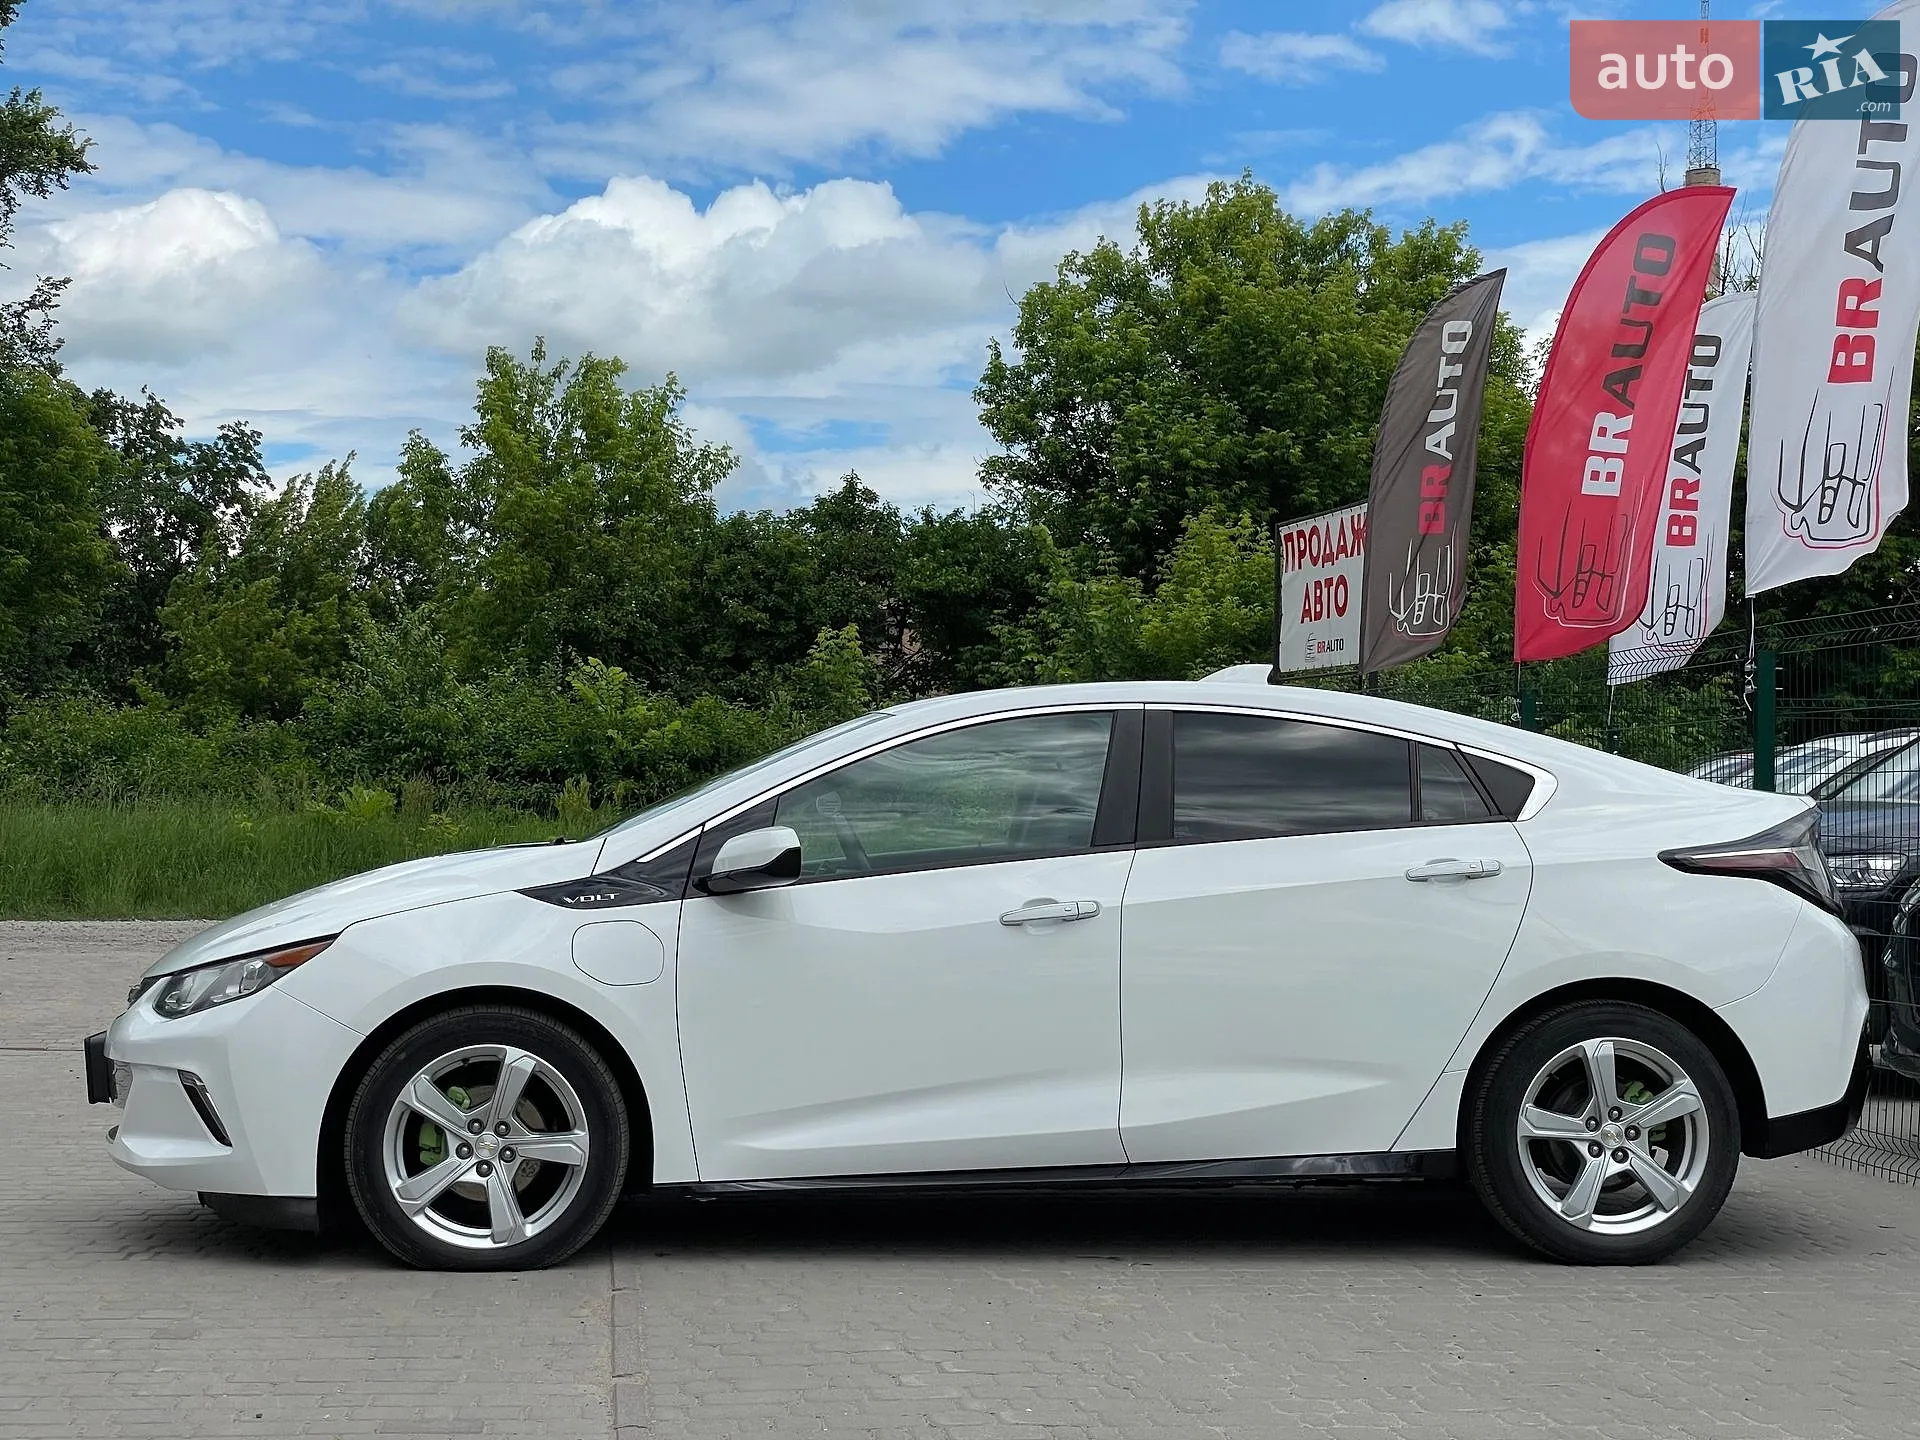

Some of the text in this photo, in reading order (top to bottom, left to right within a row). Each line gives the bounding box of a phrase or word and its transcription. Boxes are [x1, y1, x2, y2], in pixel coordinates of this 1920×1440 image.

[1827, 51, 1919, 385] BRAUTO
[1418, 319, 1474, 536] BRAUTO
[1581, 232, 1677, 497] BRAUTO
[1666, 334, 1723, 547] BRAUTO
[1300, 574, 1349, 624] АВТО
[1316, 638, 1344, 654] BRAUTO
[562, 892, 619, 904] VOLT
